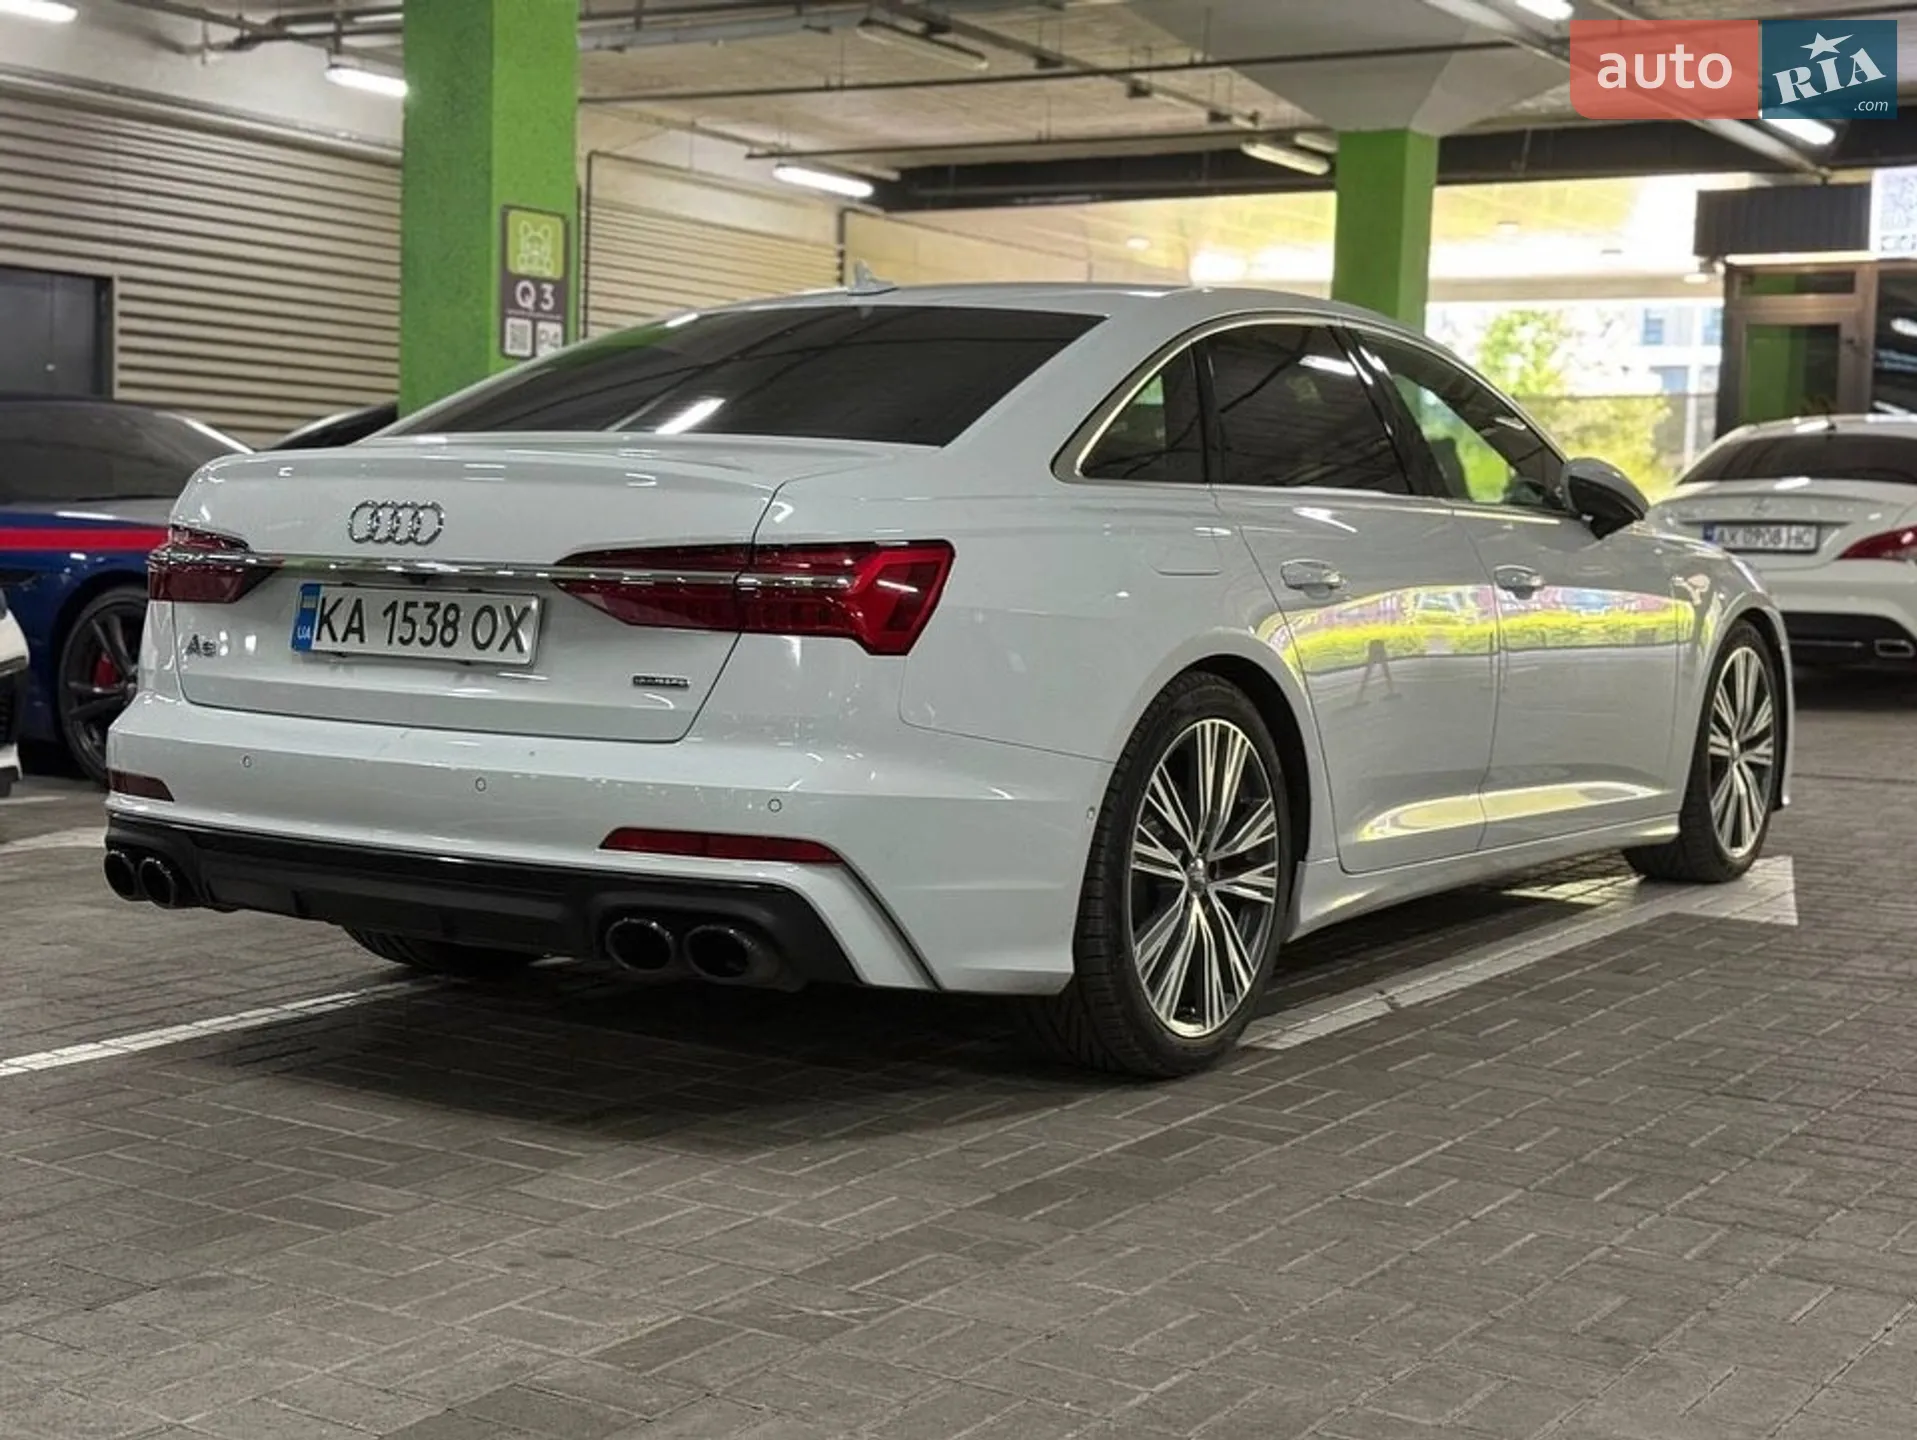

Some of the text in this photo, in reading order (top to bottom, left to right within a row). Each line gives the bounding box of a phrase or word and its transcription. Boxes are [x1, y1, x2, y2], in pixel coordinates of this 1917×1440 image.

[315, 596, 531, 654] KA 1538 OX
